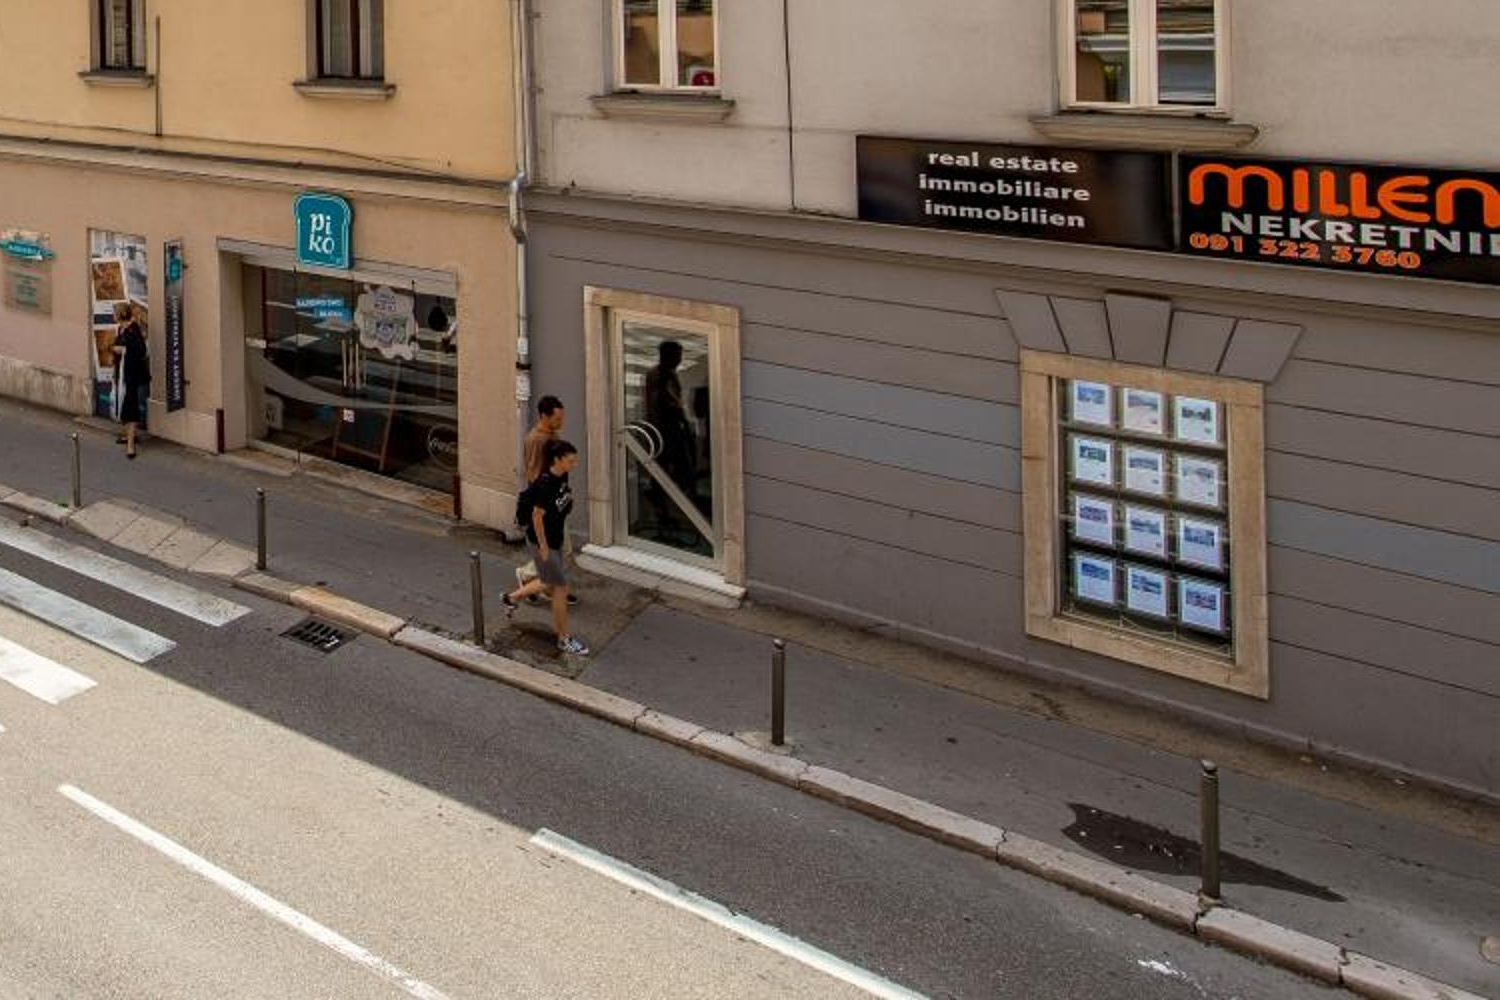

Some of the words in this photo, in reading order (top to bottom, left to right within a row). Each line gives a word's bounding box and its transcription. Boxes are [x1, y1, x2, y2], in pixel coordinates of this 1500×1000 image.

[928, 152, 979, 167] real
[990, 156, 1079, 173] estate
[918, 174, 1091, 201] immobiliare
[925, 200, 1085, 228] immobilien
[1190, 232, 1243, 253] 091
